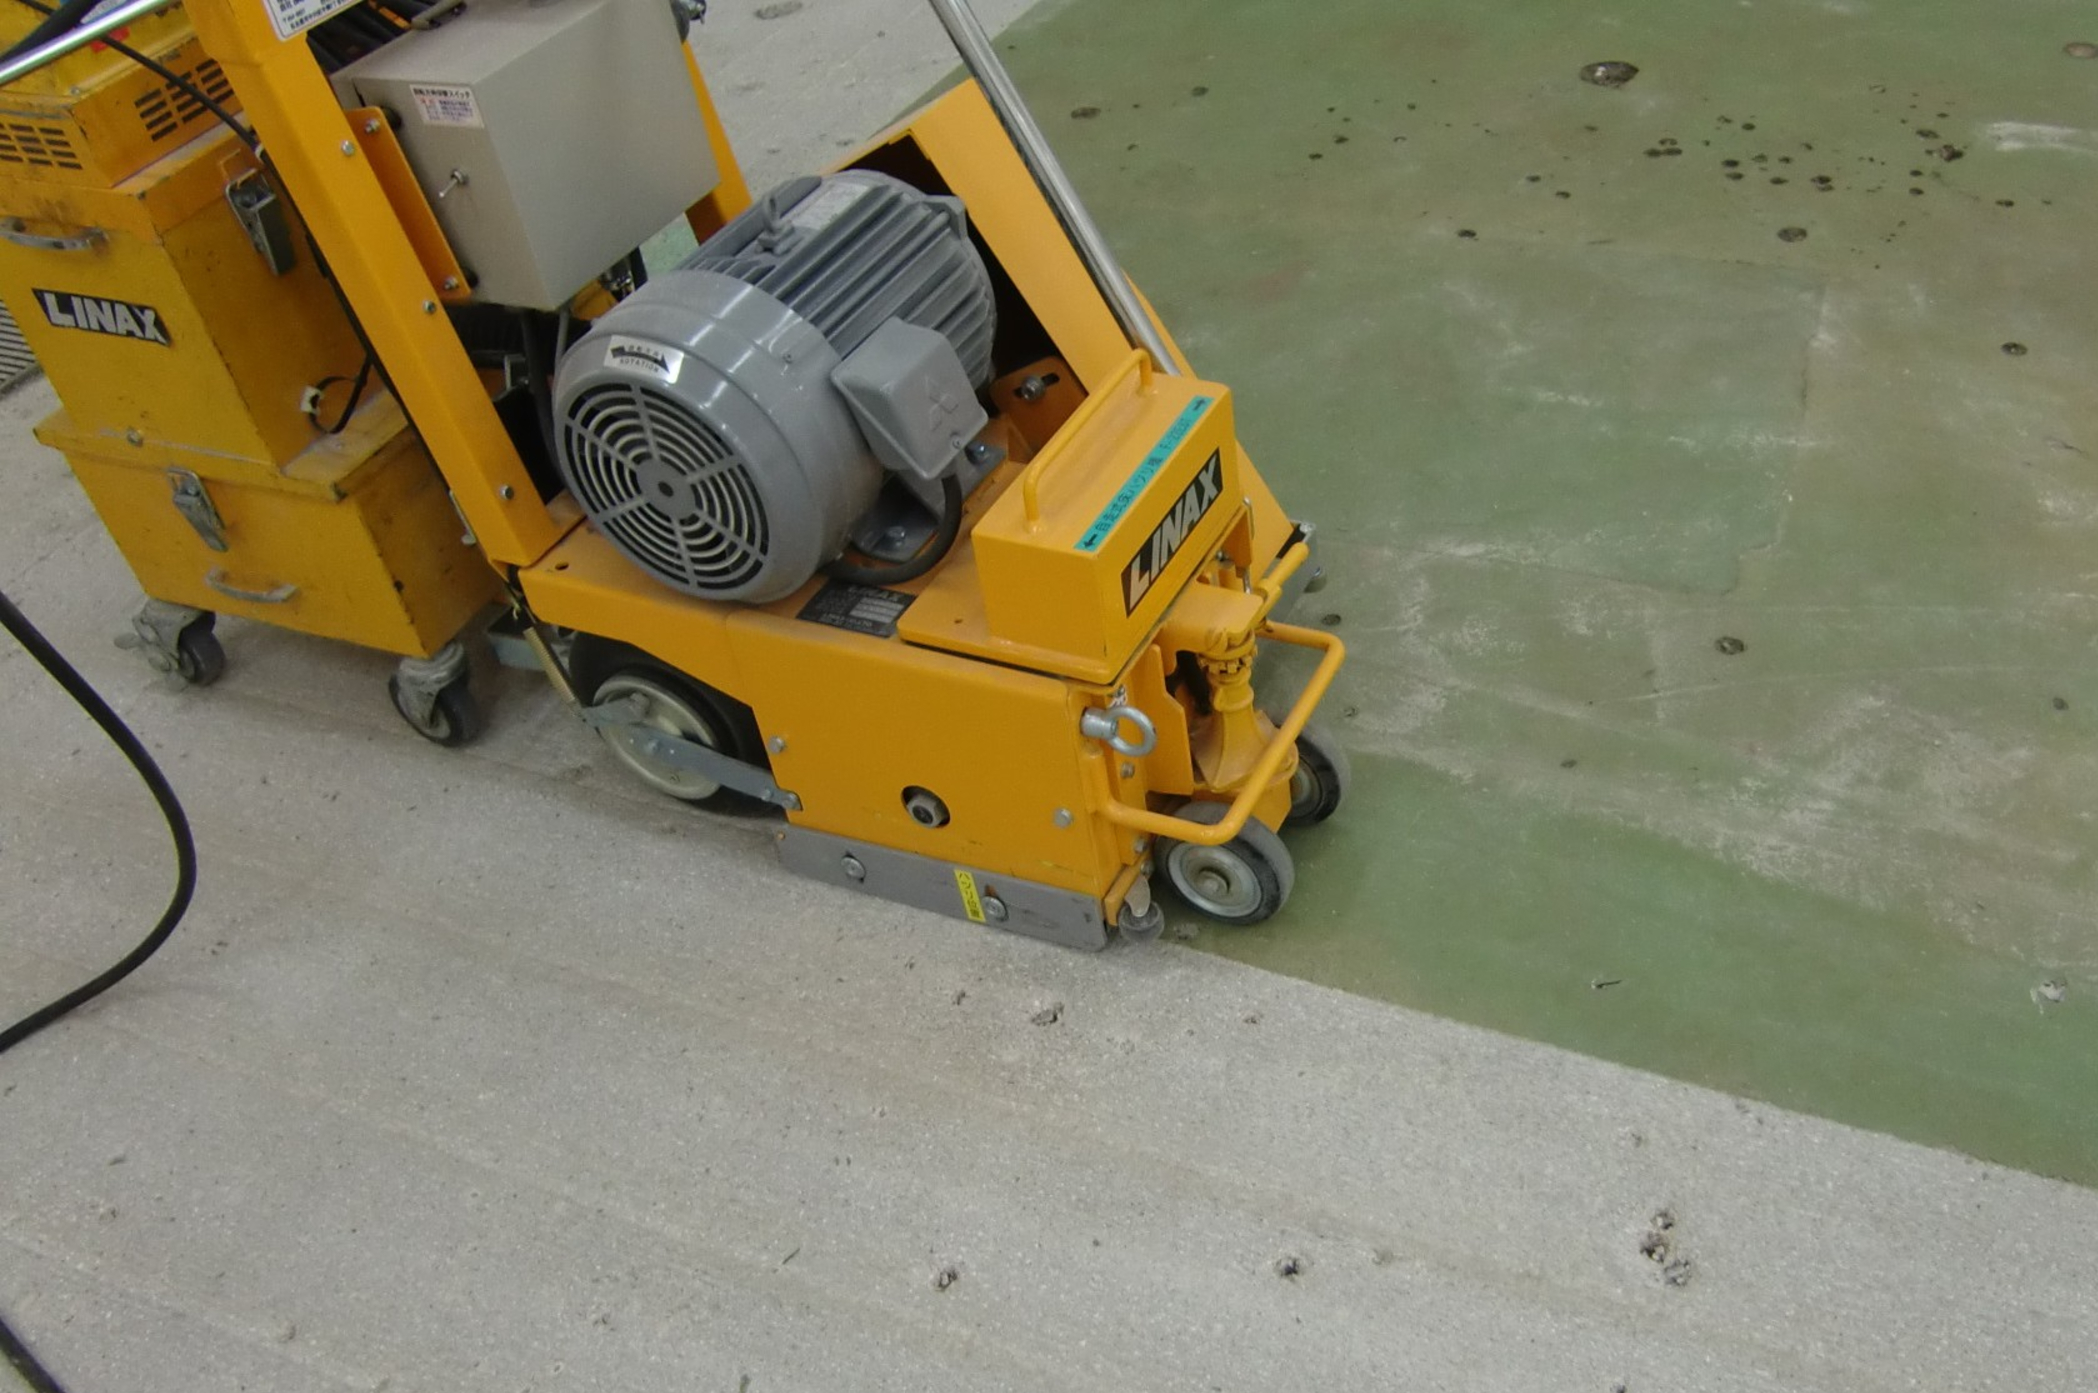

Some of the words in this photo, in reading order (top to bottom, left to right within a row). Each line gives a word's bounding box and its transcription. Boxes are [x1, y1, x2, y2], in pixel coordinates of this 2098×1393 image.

[44, 292, 165, 344] LINAX
[619, 358, 660, 373] ROTATION
[1129, 455, 1220, 611] LINAX
